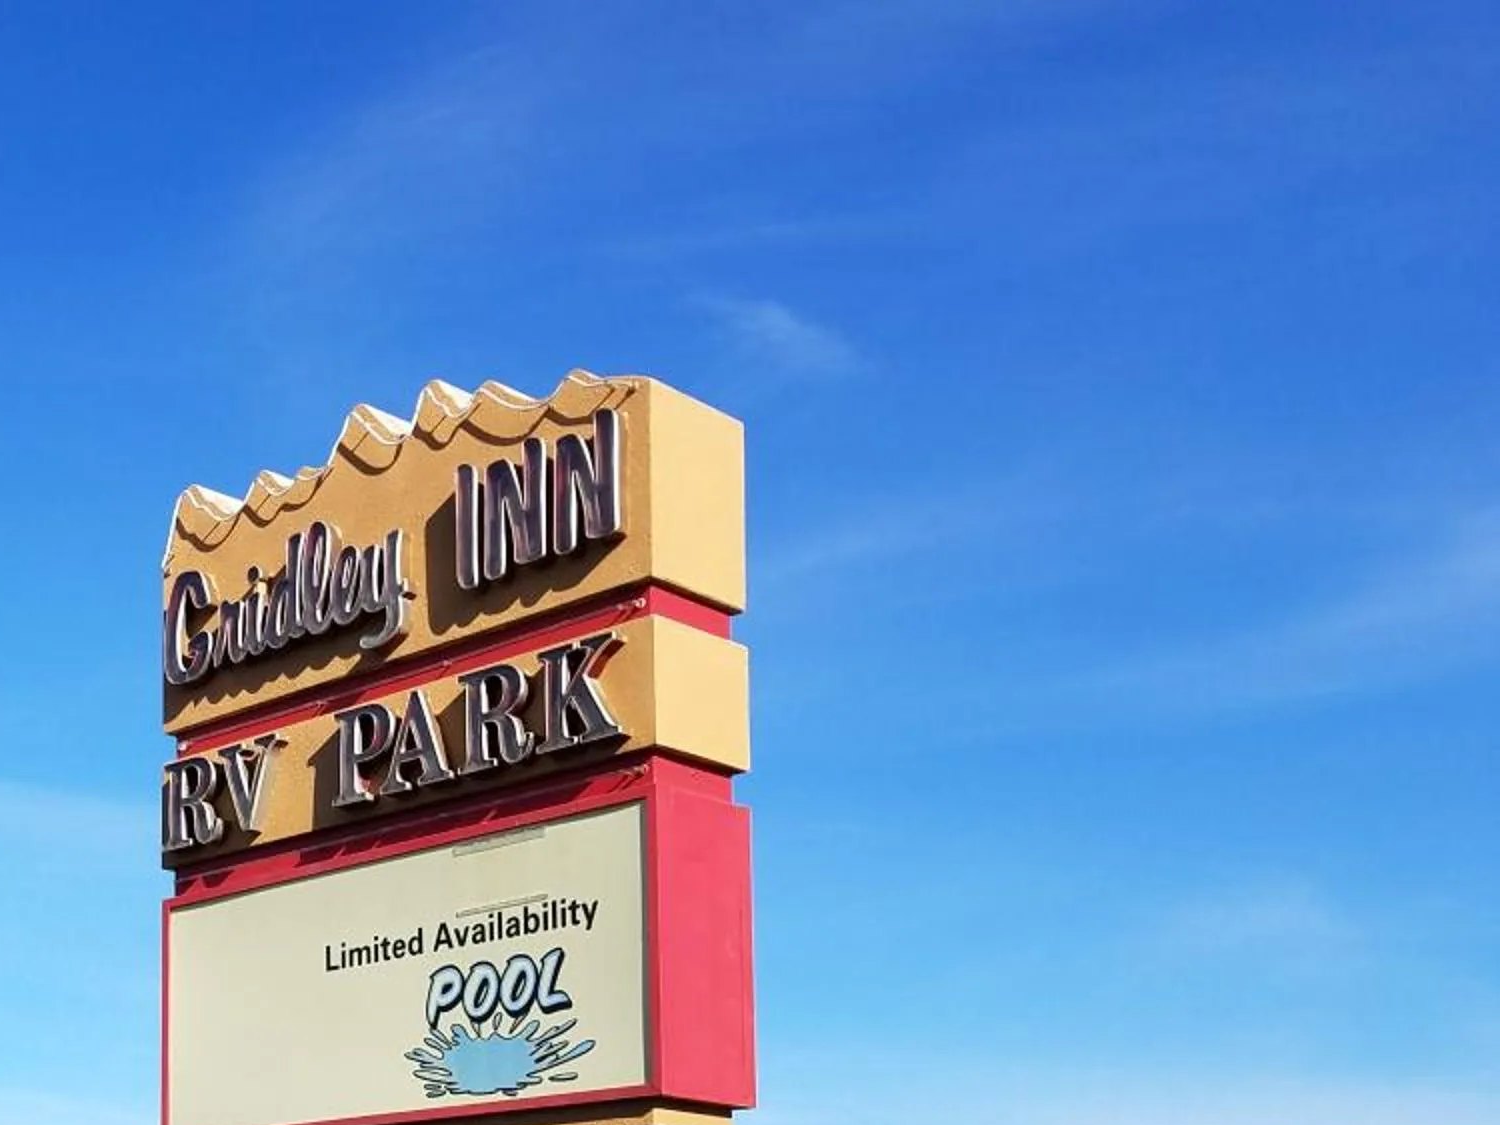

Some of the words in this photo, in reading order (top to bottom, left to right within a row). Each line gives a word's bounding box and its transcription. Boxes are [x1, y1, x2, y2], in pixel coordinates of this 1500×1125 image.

[165, 520, 411, 686] Gridley
[456, 408, 625, 590] INN
[163, 734, 288, 851] RV
[331, 631, 626, 809] PARK
[324, 927, 424, 972] Limited
[433, 899, 599, 950] Availability
[426, 947, 573, 1031] POOL
